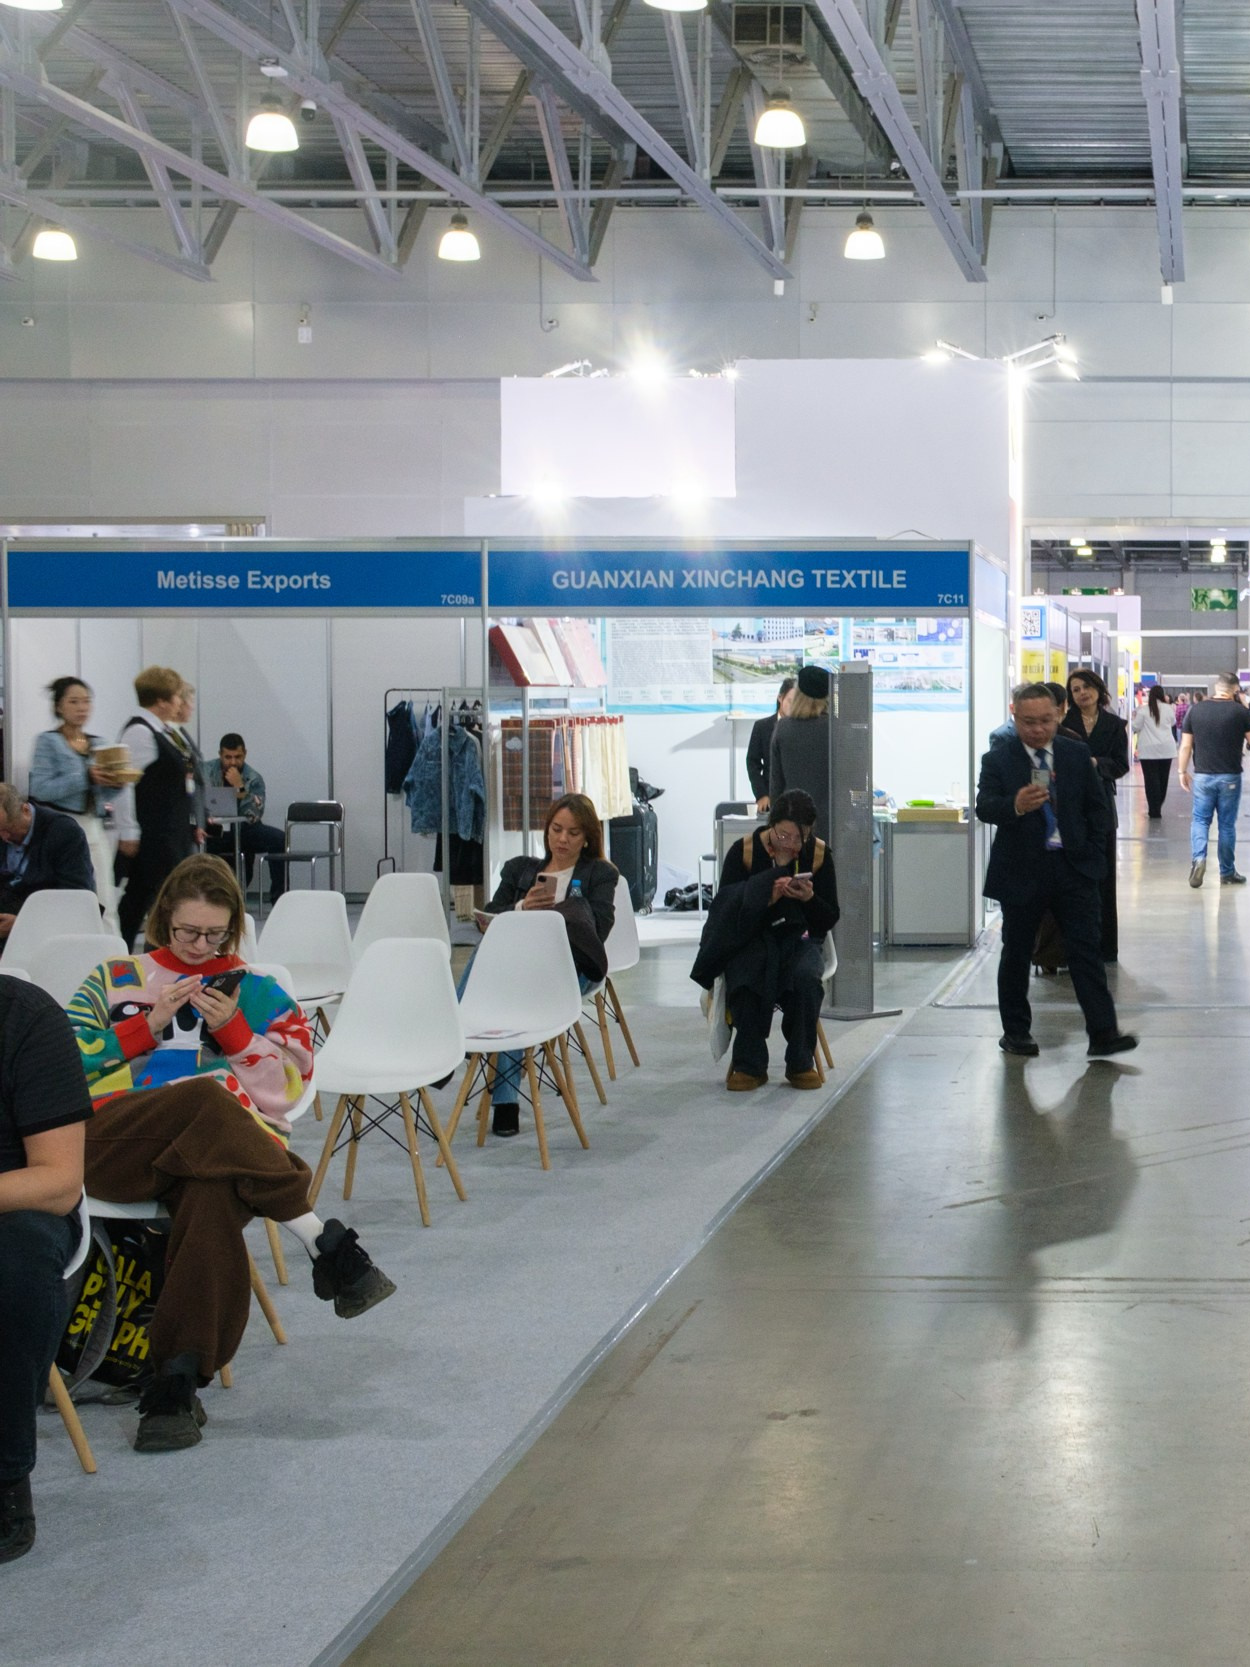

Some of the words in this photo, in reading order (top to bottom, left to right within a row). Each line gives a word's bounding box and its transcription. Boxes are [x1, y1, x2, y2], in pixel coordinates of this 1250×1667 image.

[156, 570, 240, 589] Metisse
[247, 570, 332, 593] Exports
[552, 569, 675, 590] GUANXIAN
[681, 569, 805, 589] XINCHANG
[811, 569, 907, 589] TEXTILE
[440, 594, 475, 605] 7C09a
[937, 593, 965, 604] 7C11
[67, 1303, 151, 1361] GRPH
